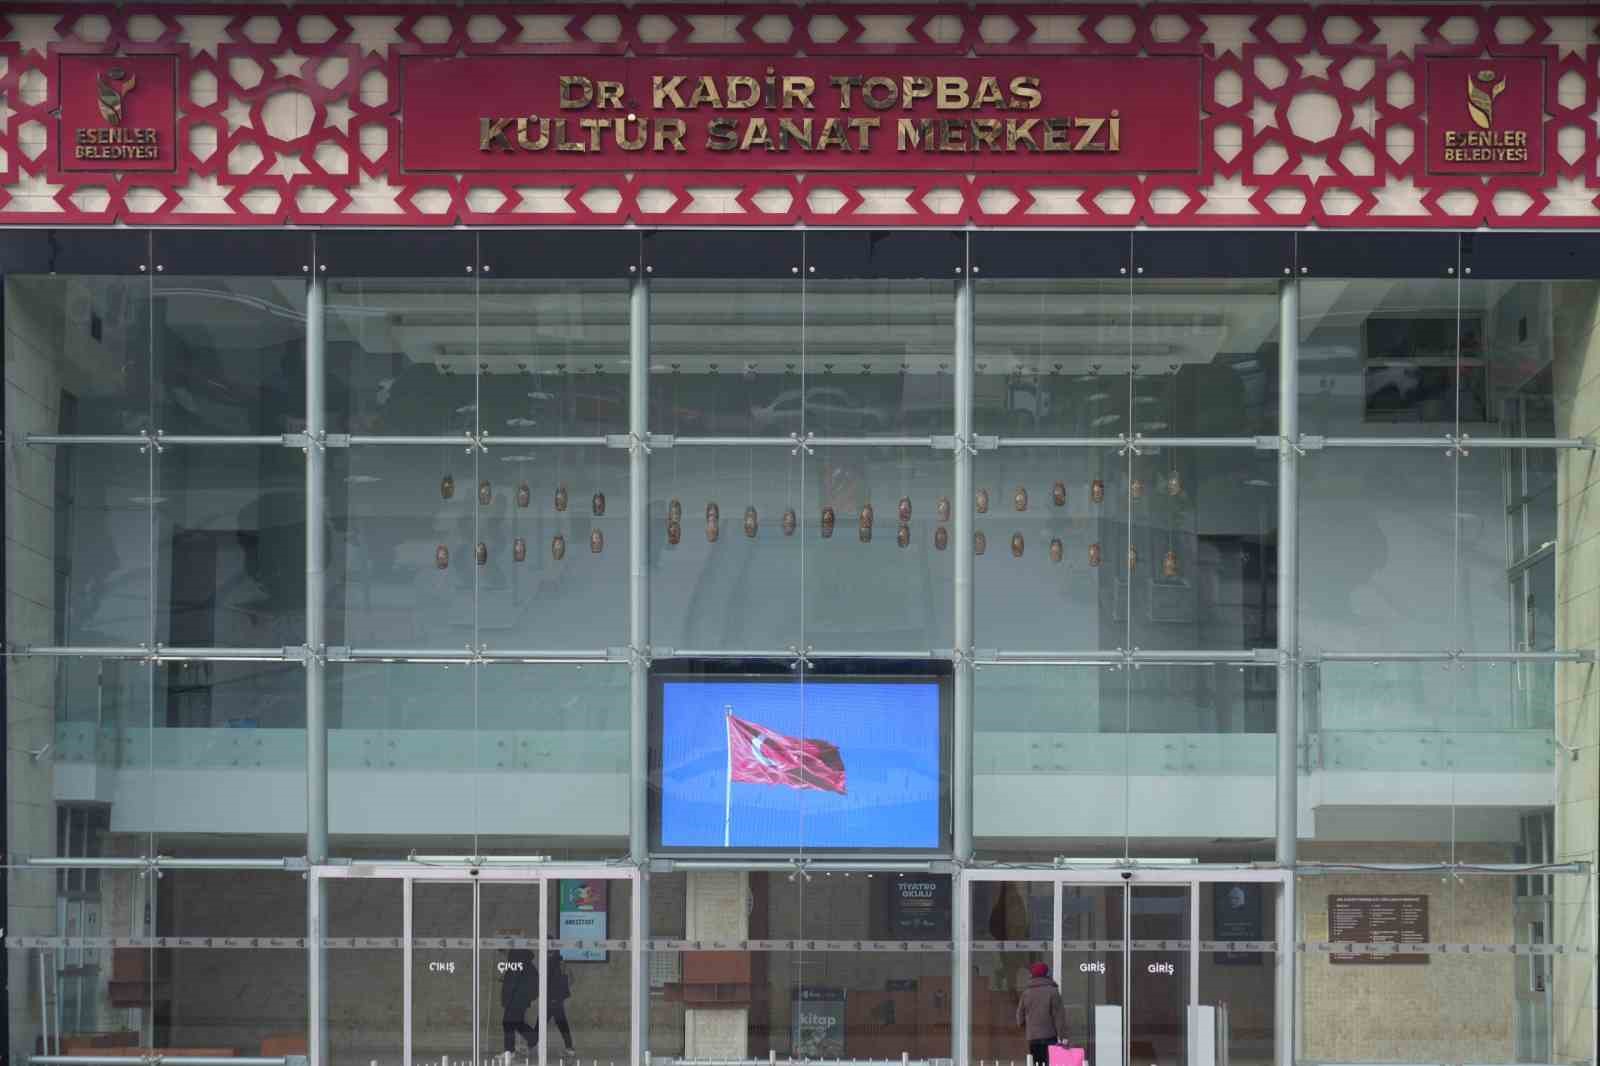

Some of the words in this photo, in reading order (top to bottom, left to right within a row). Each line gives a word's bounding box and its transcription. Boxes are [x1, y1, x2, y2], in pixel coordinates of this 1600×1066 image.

[651, 66, 815, 109] KADİR
[75, 127, 157, 144] ESENLER
[479, 113, 687, 152] KÜLTÜR
[705, 116, 881, 152] SANAT
[896, 109, 1121, 152] MERKEZİ
[1445, 130, 1527, 147] ESENLER
